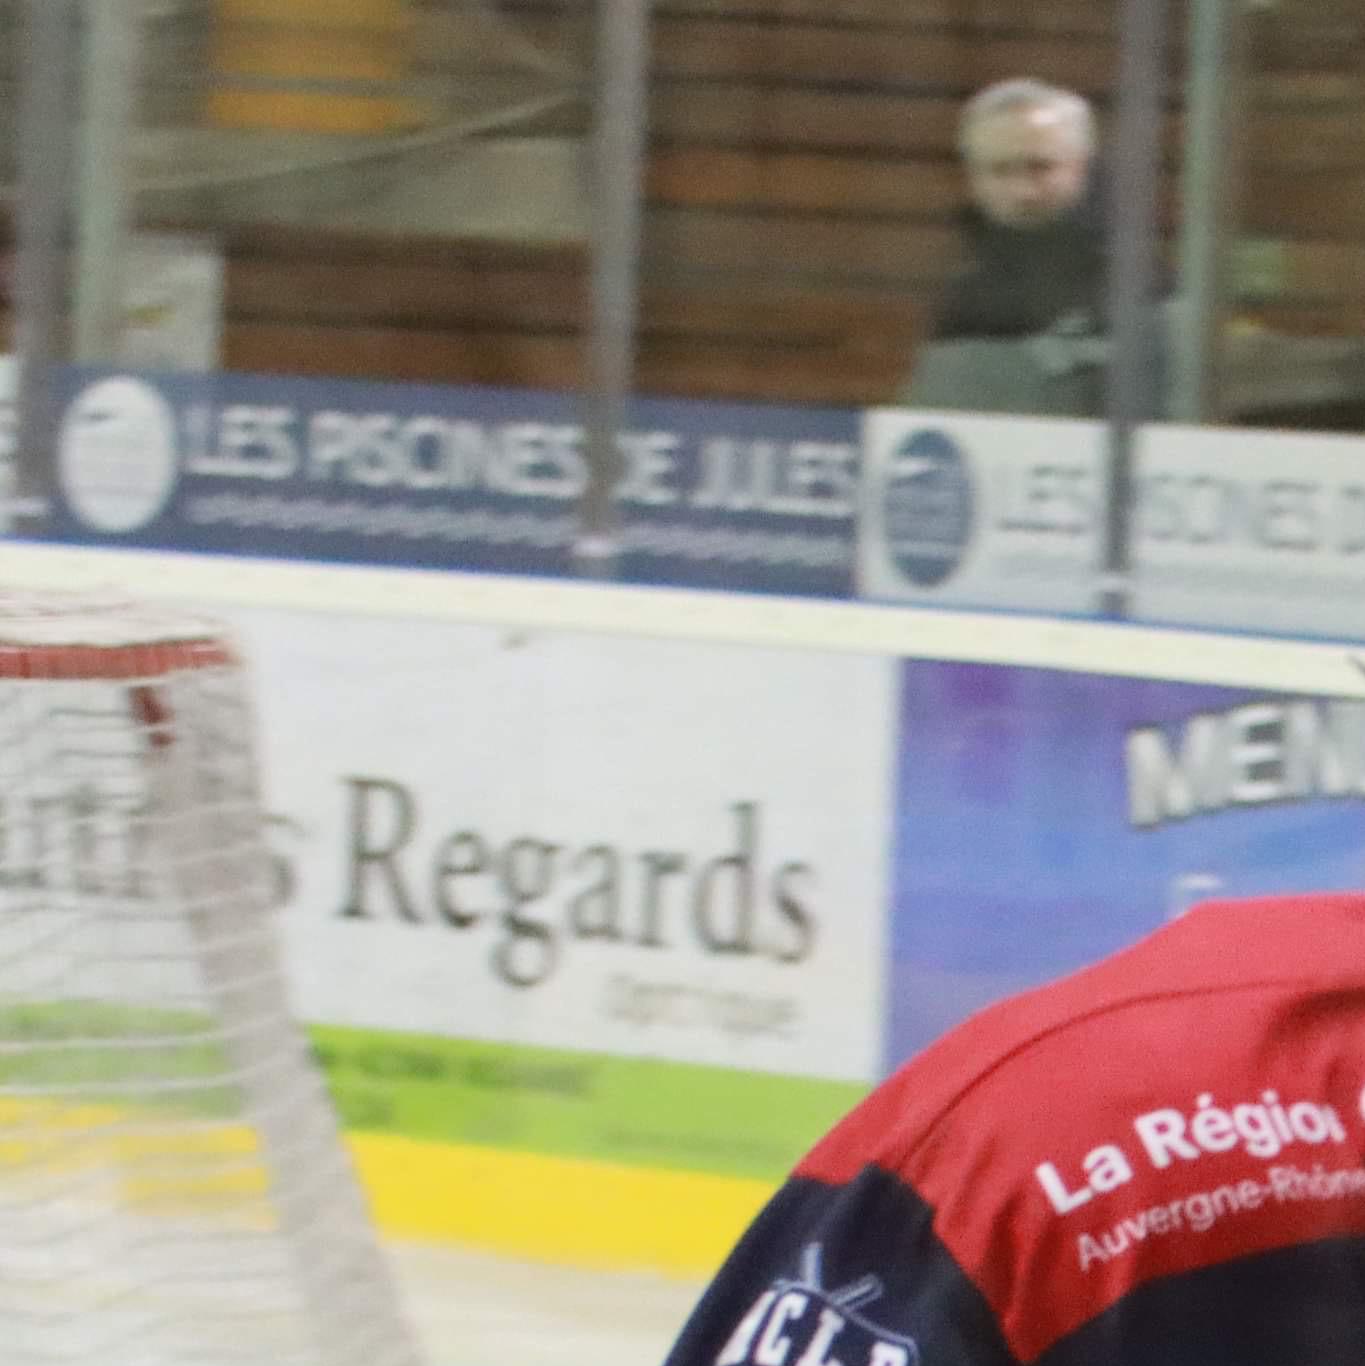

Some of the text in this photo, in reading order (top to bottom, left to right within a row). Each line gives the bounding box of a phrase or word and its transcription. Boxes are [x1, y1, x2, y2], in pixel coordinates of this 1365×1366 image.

[185, 403, 299, 481] LES
[688, 440, 861, 519] JULES
[339, 774, 821, 987] Regards
[1034, 1142, 1133, 1215] La
